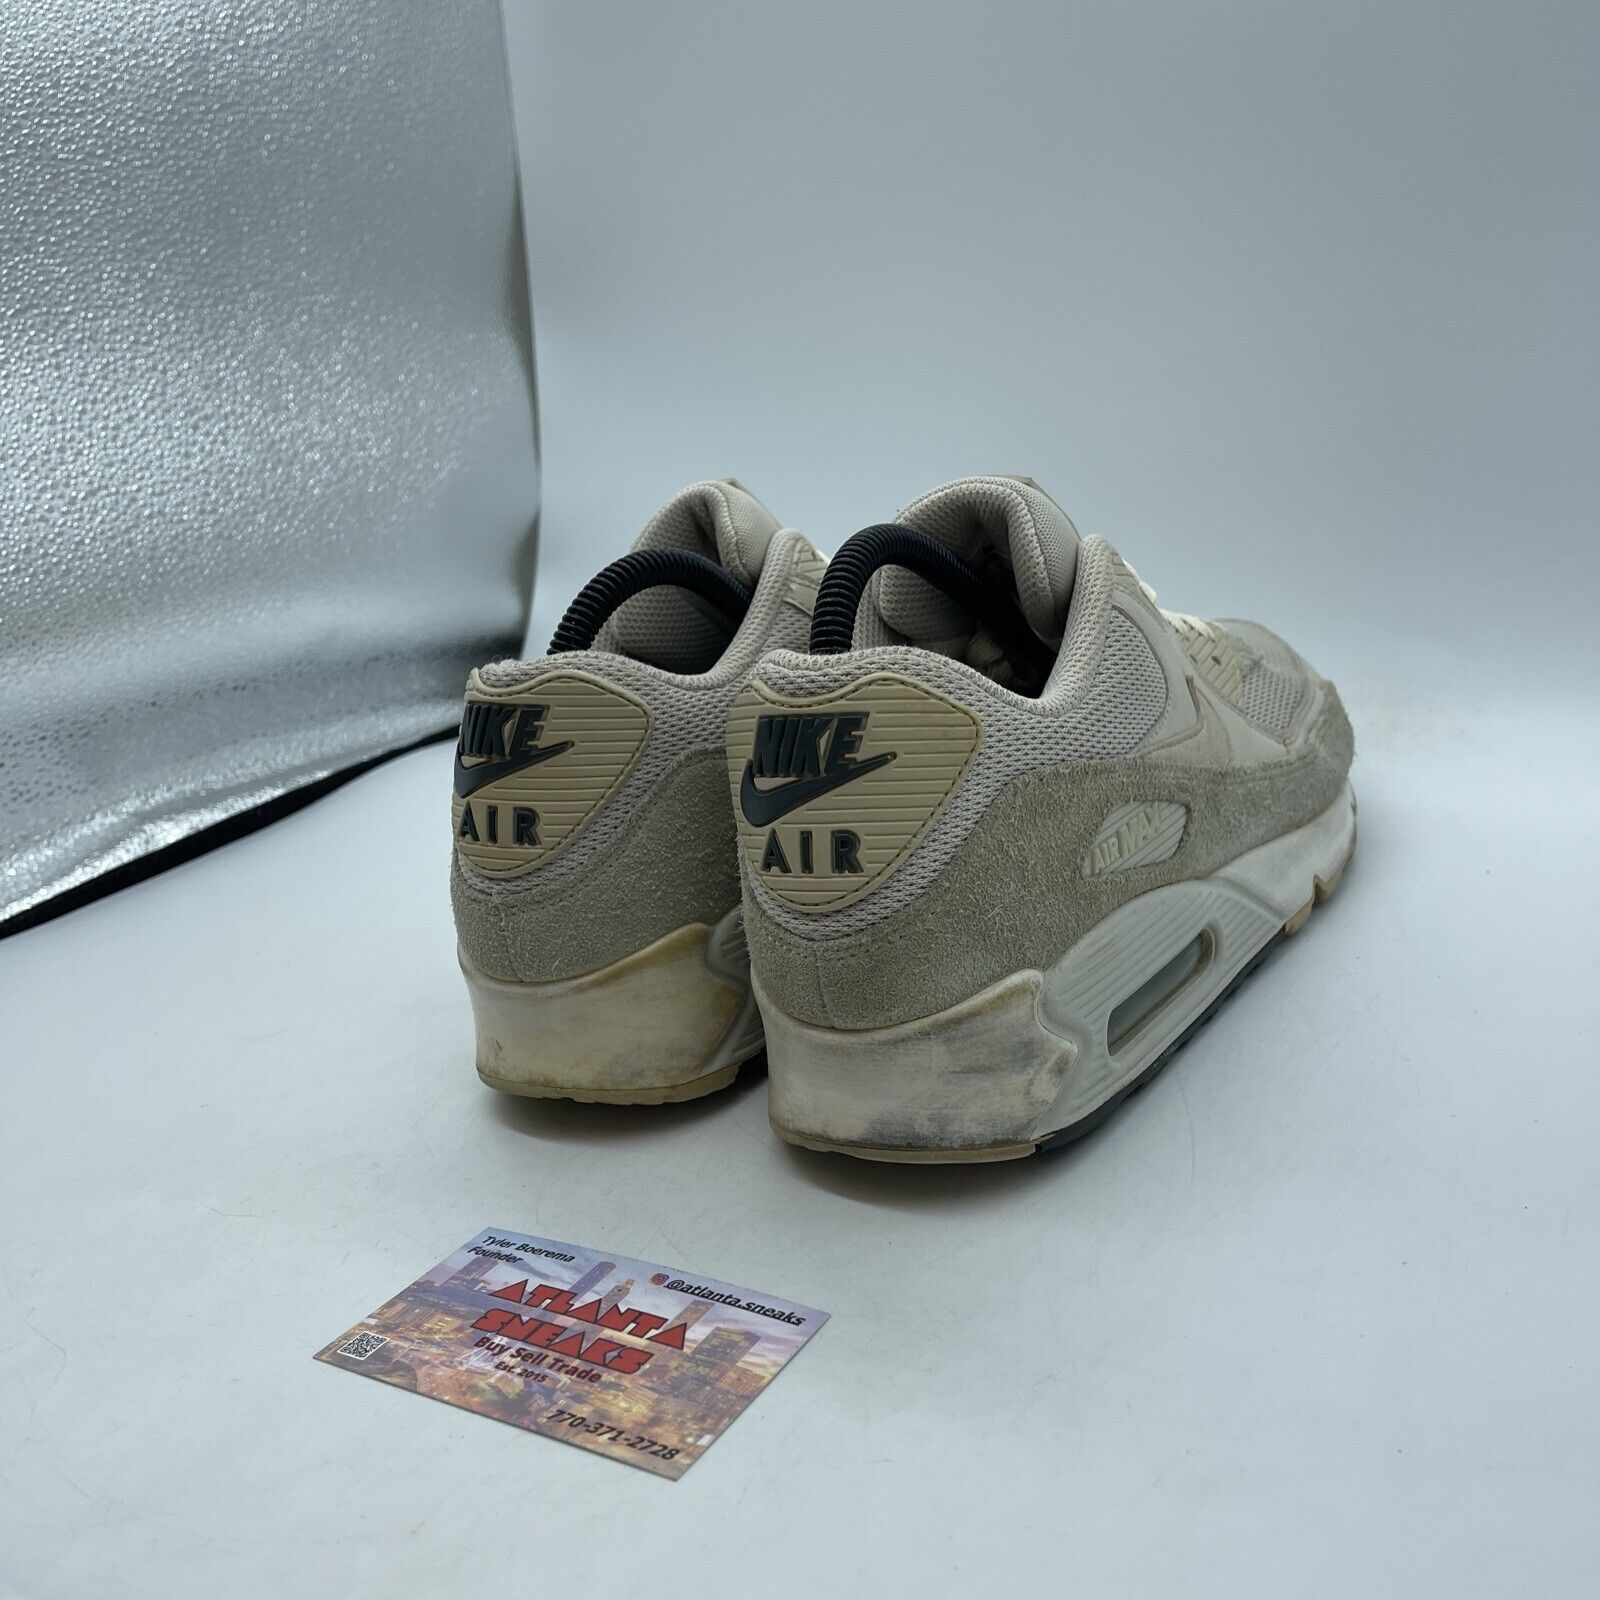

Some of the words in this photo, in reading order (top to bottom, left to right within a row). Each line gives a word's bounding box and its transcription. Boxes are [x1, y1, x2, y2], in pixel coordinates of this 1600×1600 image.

[461, 700, 550, 757] NIKE
[752, 711, 870, 777] NIKE
[458, 801, 542, 846] AIR
[1090, 837, 1121, 875] AIR
[1119, 801, 1162, 858] MAX
[760, 828, 864, 874] AIR
[467, 1246, 524, 1264] Founder
[482, 1236, 516, 1249] Tyler
[515, 1243, 576, 1263] Boerema
[488, 1279, 687, 1350] ATLANTA
[664, 1279, 806, 1326] @atlanta.sneaks
[470, 1308, 654, 1374] SNEAKS
[473, 1337, 510, 1356] Buy
[510, 1347, 549, 1366] Sell
[549, 1357, 601, 1383] Trade
[495, 1361, 516, 1375] Est.
[517, 1368, 548, 1382] 2015
[546, 1409, 681, 1460] 770-371-2728
